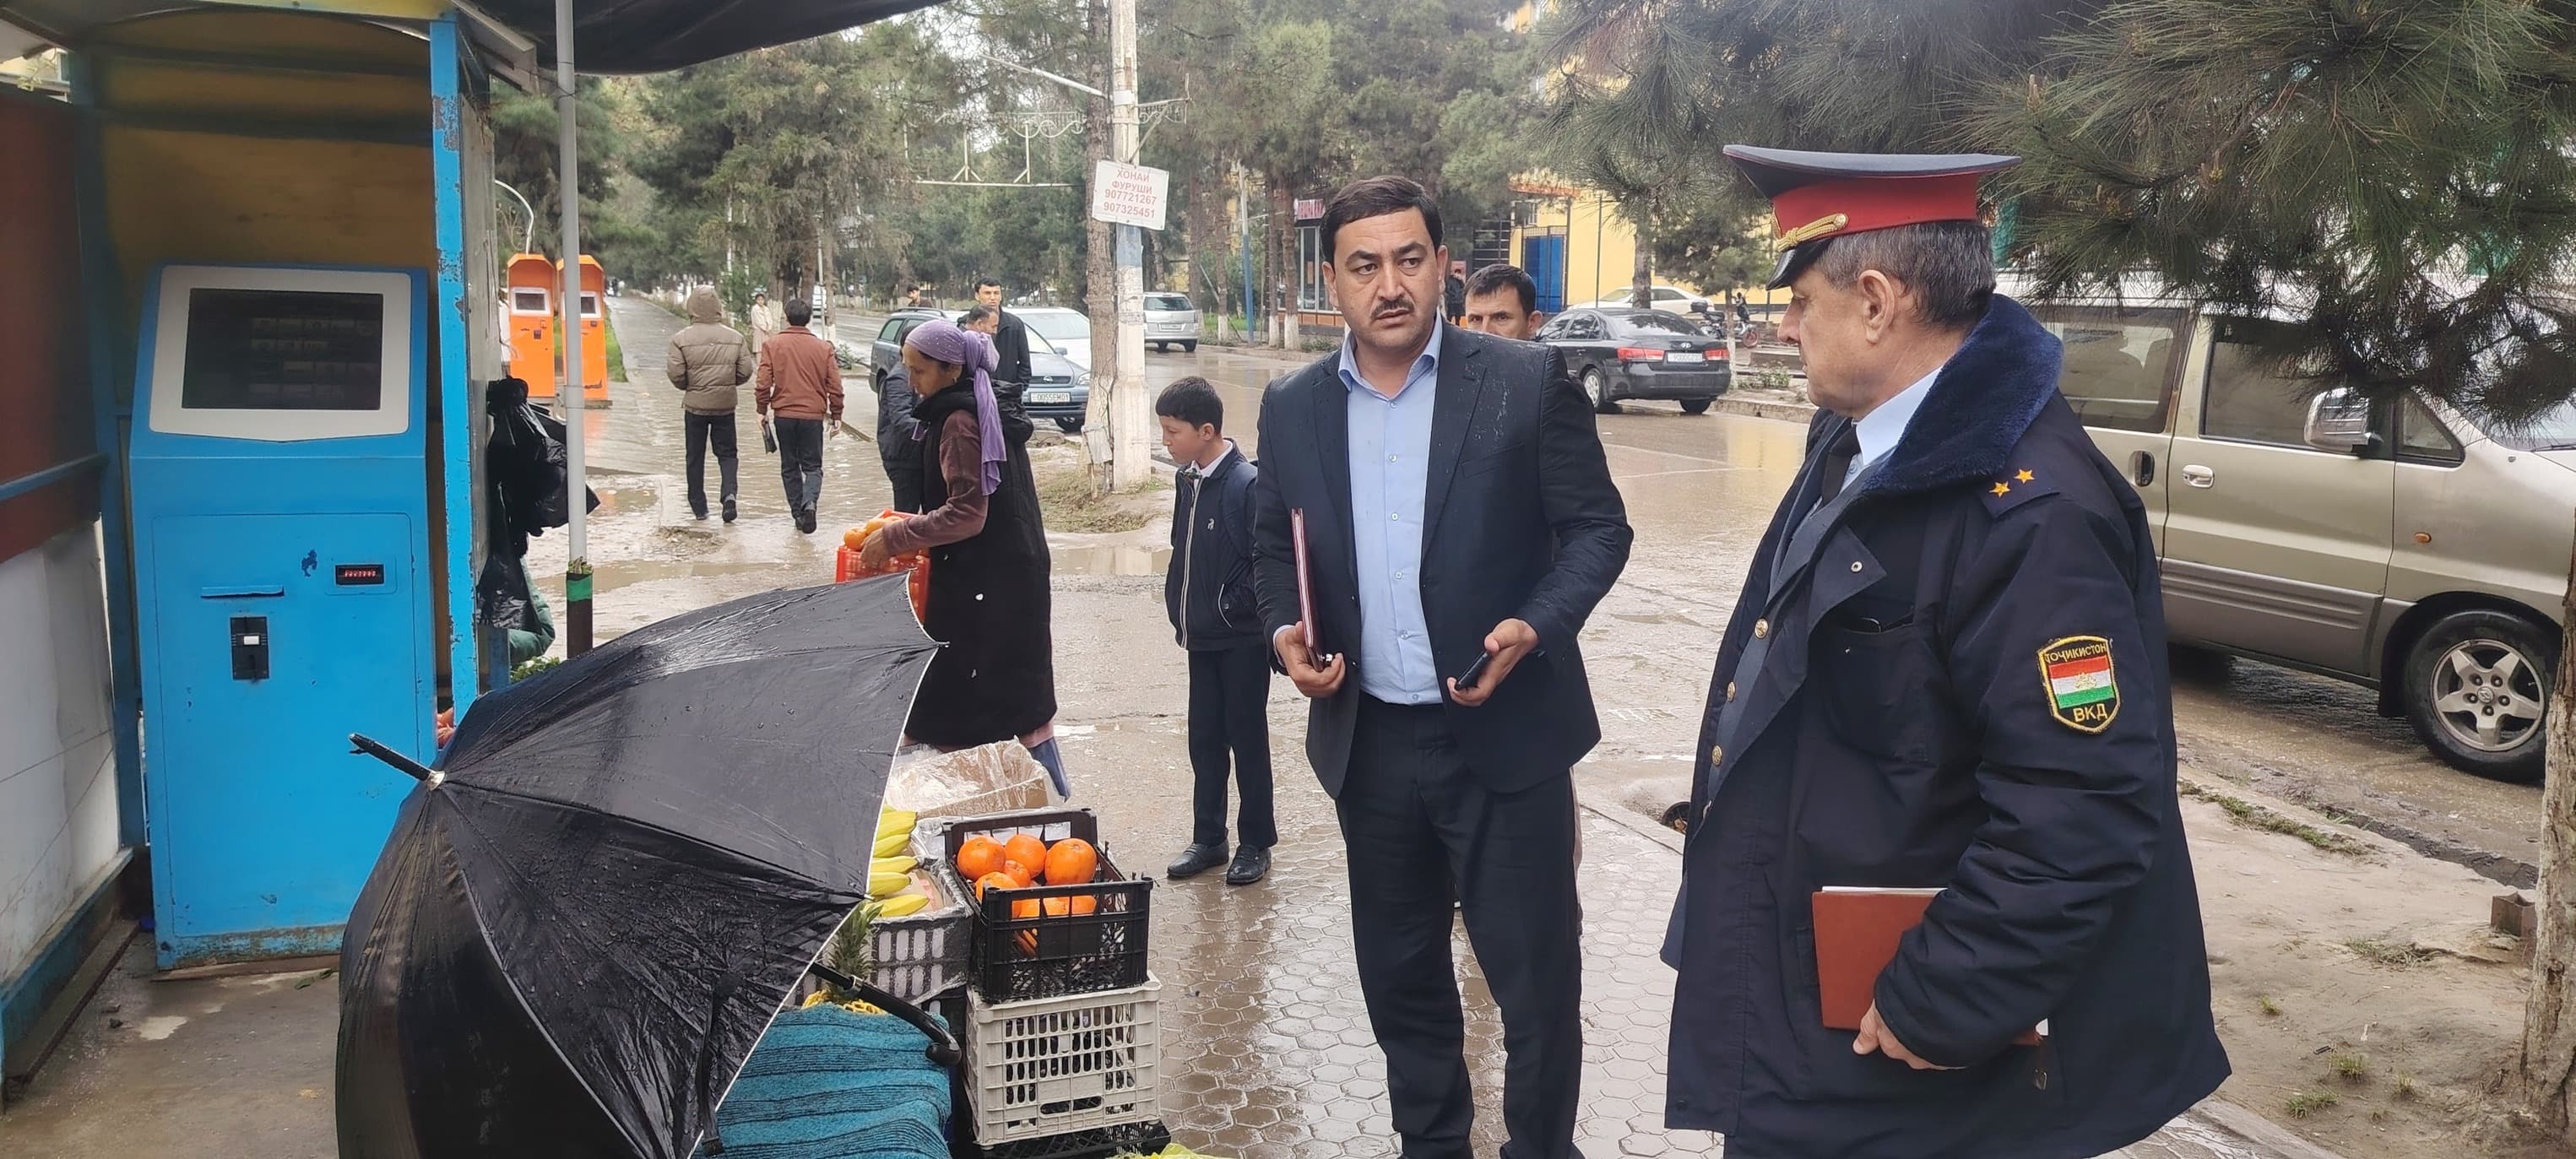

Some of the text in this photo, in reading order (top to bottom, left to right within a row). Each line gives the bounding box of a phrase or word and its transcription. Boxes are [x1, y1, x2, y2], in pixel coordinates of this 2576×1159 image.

[1111, 180, 1152, 194] ФУРУШИ
[1104, 188, 1158, 205] 907721267
[1104, 202, 1156, 218] 907325451
[2073, 703, 2108, 723] ВКД
